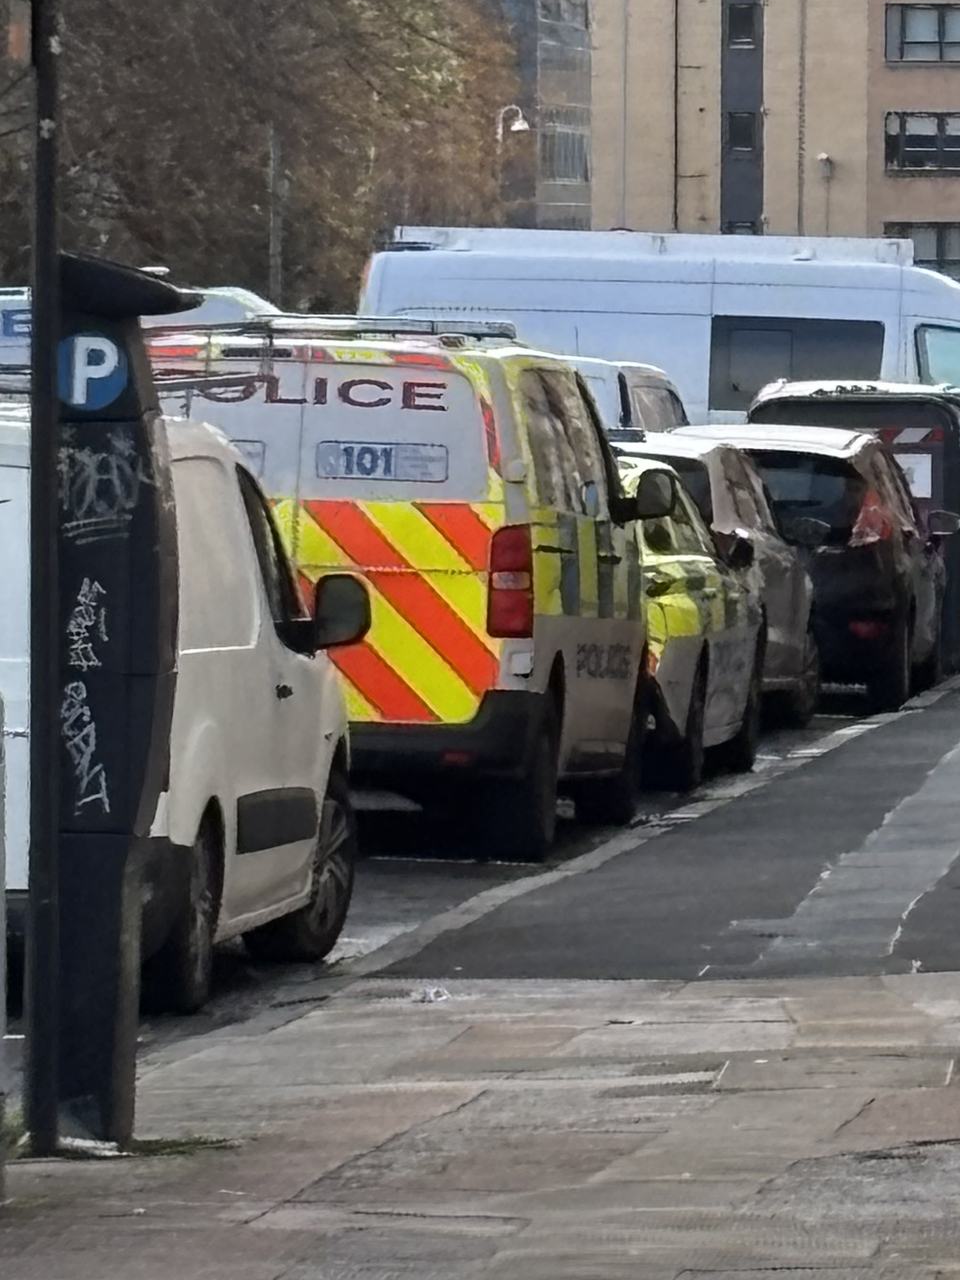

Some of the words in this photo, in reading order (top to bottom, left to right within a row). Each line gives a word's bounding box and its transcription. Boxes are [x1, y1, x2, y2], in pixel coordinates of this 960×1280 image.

[73, 336, 119, 405] P
[196, 375, 449, 412] OLICE
[341, 445, 394, 477] 101
